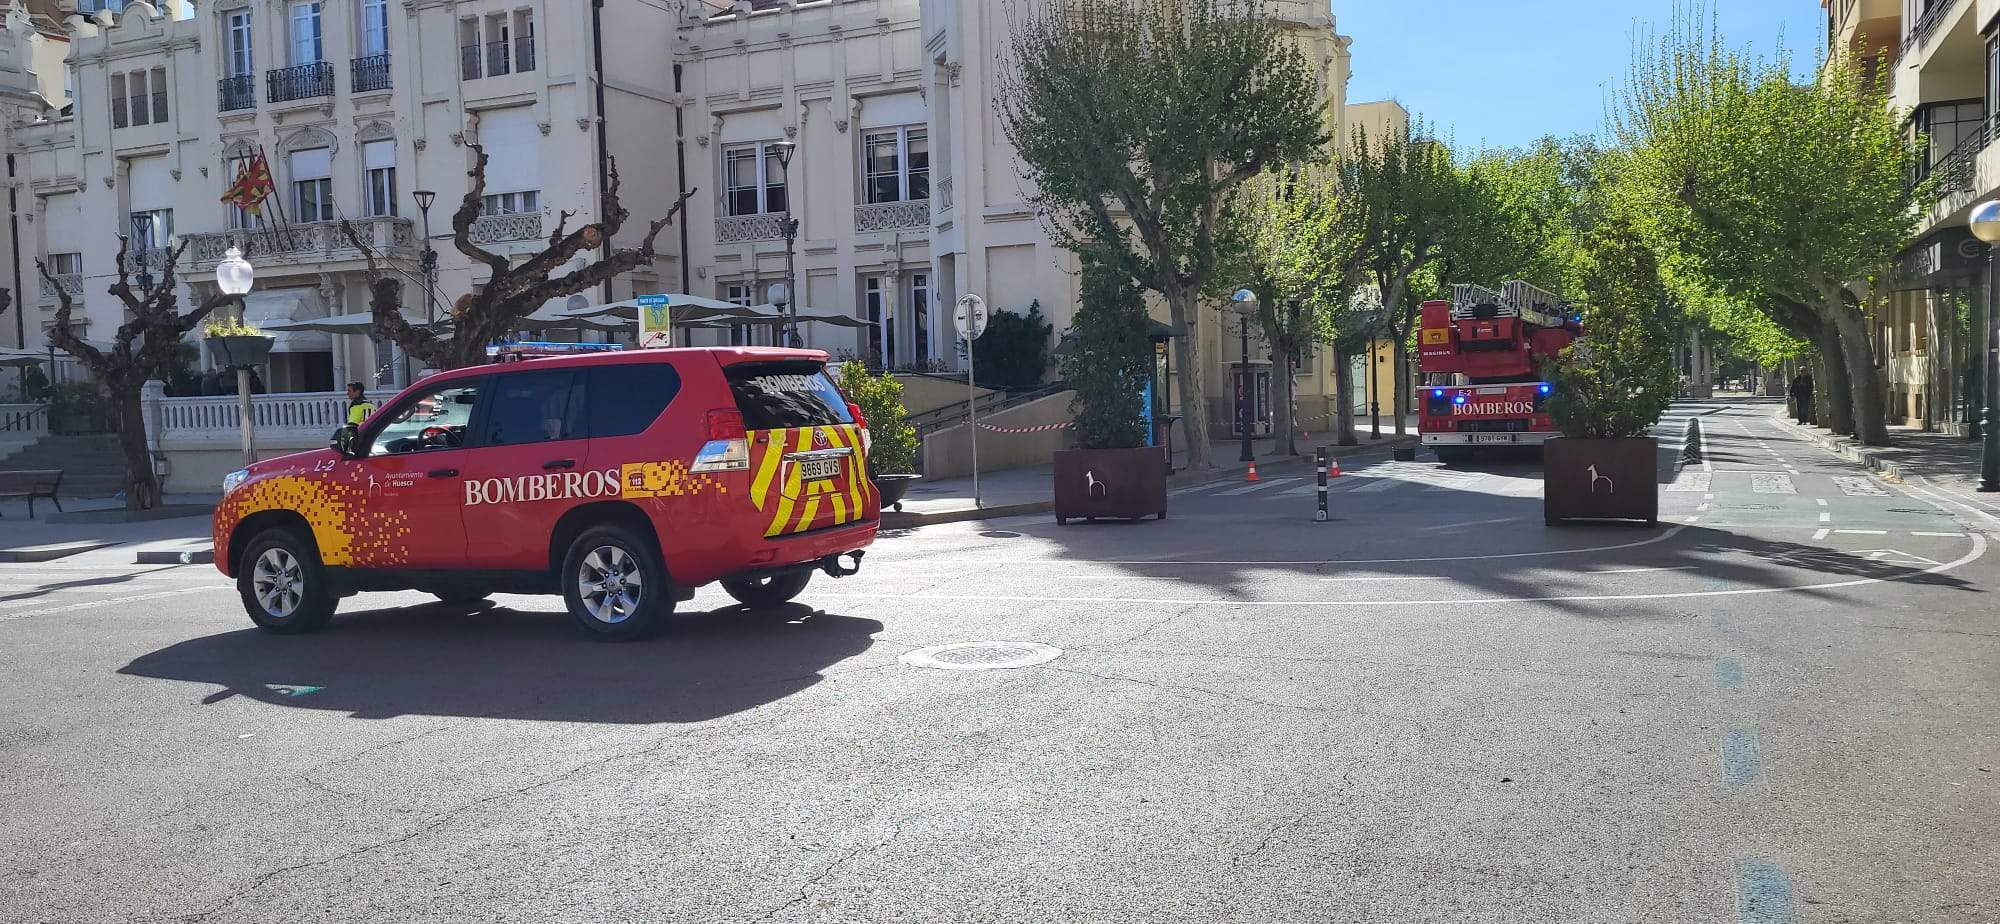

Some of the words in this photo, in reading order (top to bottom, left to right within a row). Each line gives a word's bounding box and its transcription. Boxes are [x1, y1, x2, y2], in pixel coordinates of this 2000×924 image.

[755, 374, 826, 394] BOMBEROS
[1458, 389, 1472, 397] E-2
[1453, 401, 1534, 416] BOMBEROS
[314, 460, 336, 472] L-2
[801, 462, 822, 477] 9869
[823, 460, 839, 474] GVS
[385, 471, 424, 481] Ayuntamiento
[631, 477, 642, 486] 112
[384, 480, 392, 488] de
[464, 468, 621, 506] BOMBEROS
